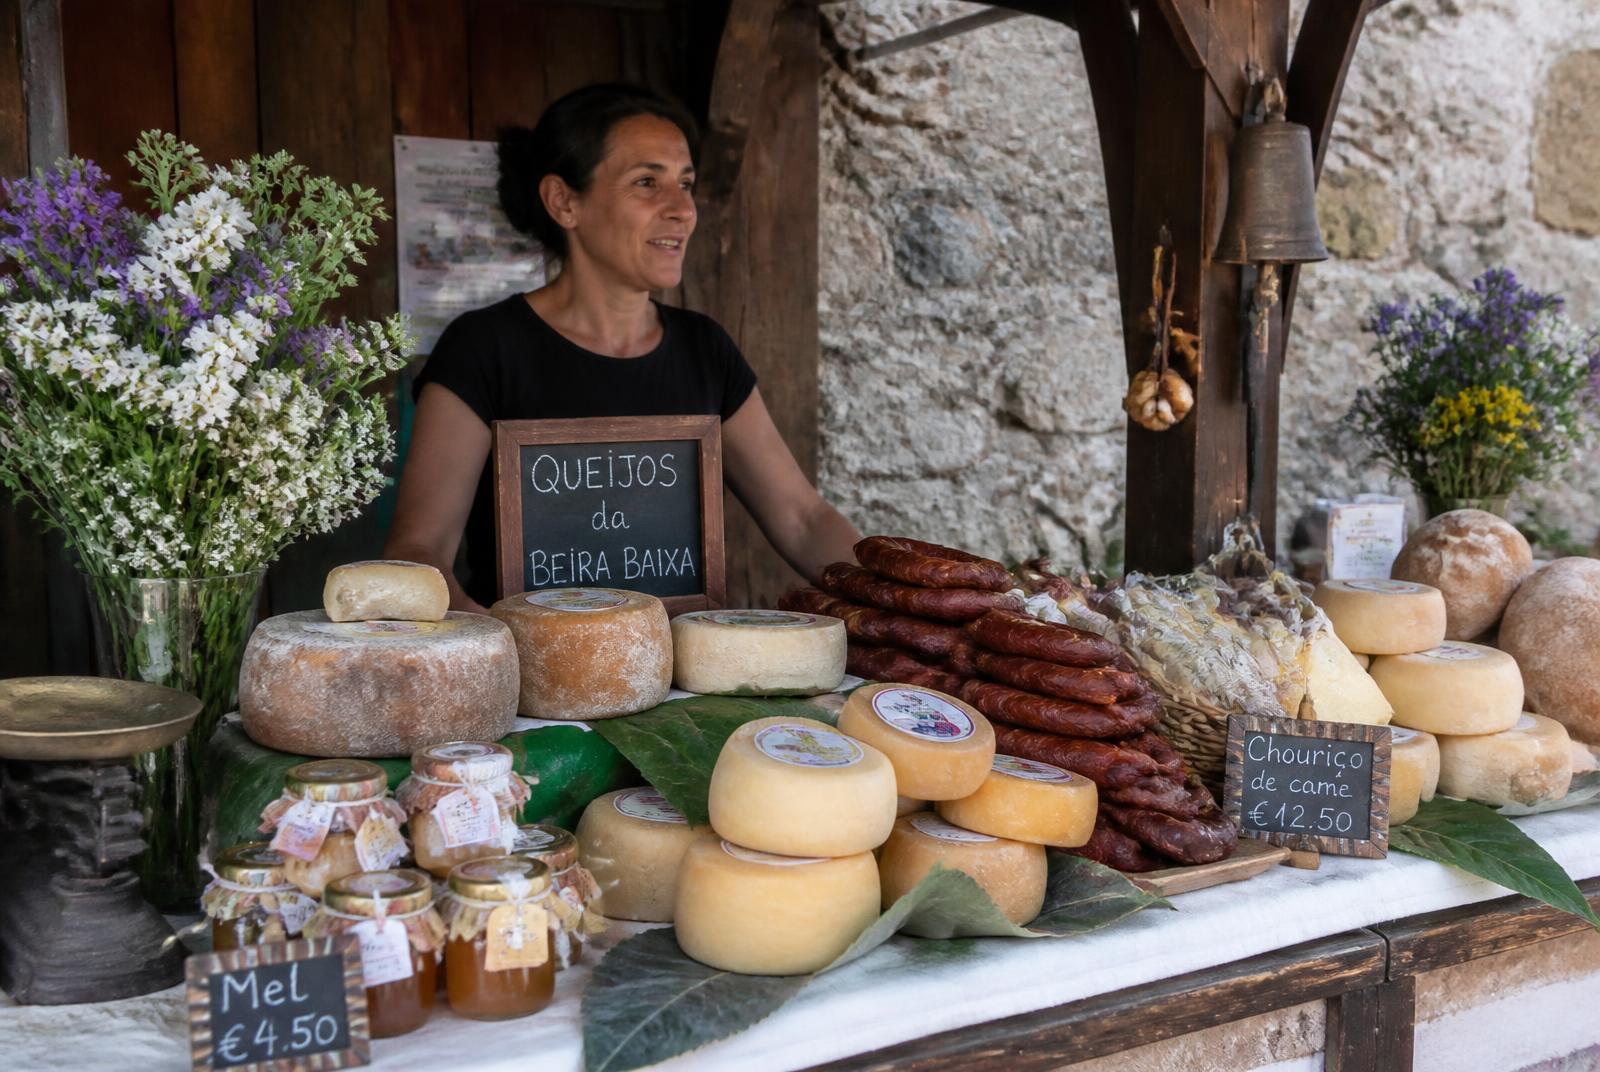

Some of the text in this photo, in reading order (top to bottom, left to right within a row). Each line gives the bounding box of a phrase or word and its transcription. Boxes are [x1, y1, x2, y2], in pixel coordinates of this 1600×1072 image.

[531, 449, 678, 494] QUEIJOS
[591, 499, 631, 530] da
[529, 546, 696, 587] BEIRA BAIXA
[1248, 735, 1363, 771] Chouriço
[1251, 769, 1277, 792] de
[221, 961, 309, 1014] Mel
